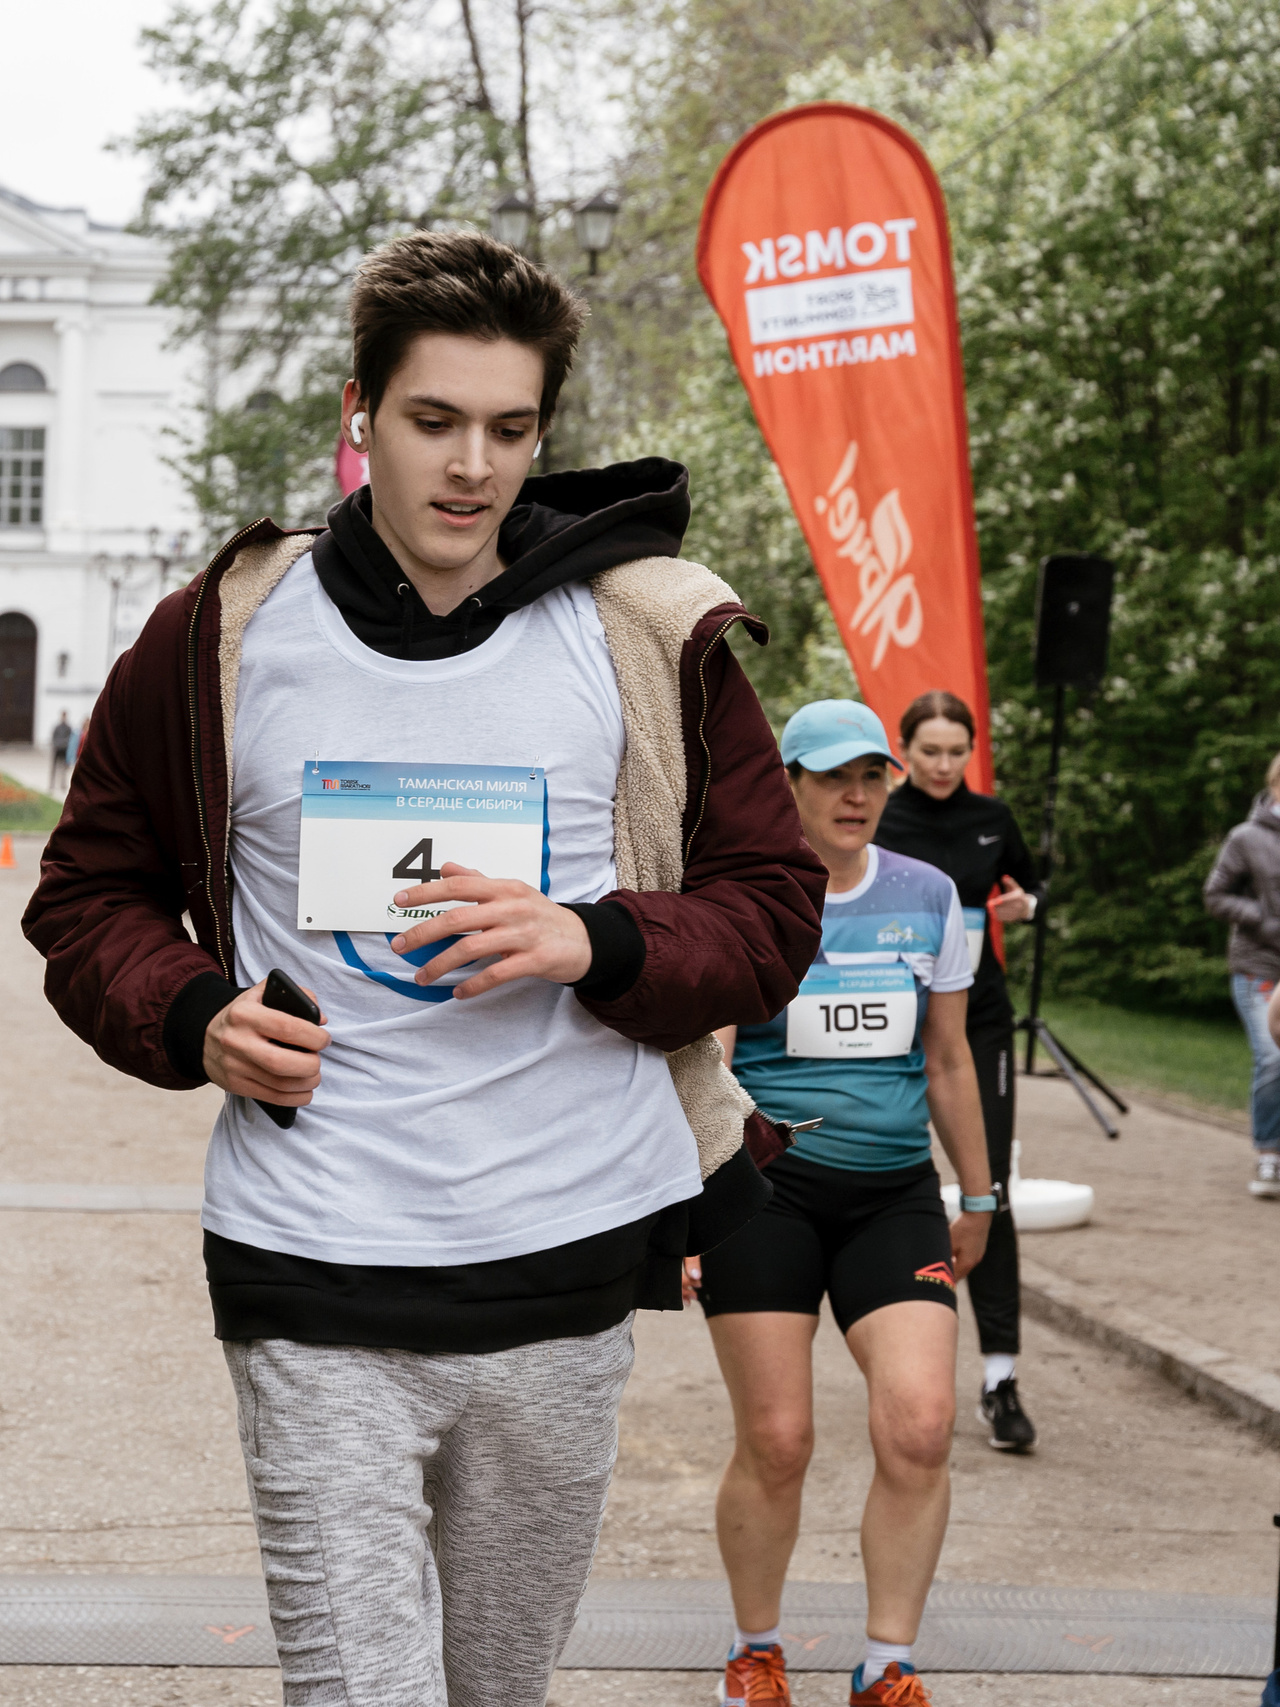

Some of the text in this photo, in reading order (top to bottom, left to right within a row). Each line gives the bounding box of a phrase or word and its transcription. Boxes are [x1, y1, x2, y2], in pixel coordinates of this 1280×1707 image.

[397, 777, 528, 793] ТАМАНСКАЯ МИЛЯ
[396, 796, 523, 811] В СЕРДЦЕ СИБИРИ
[392, 838, 441, 884] 4
[819, 1002, 889, 1033] 105
